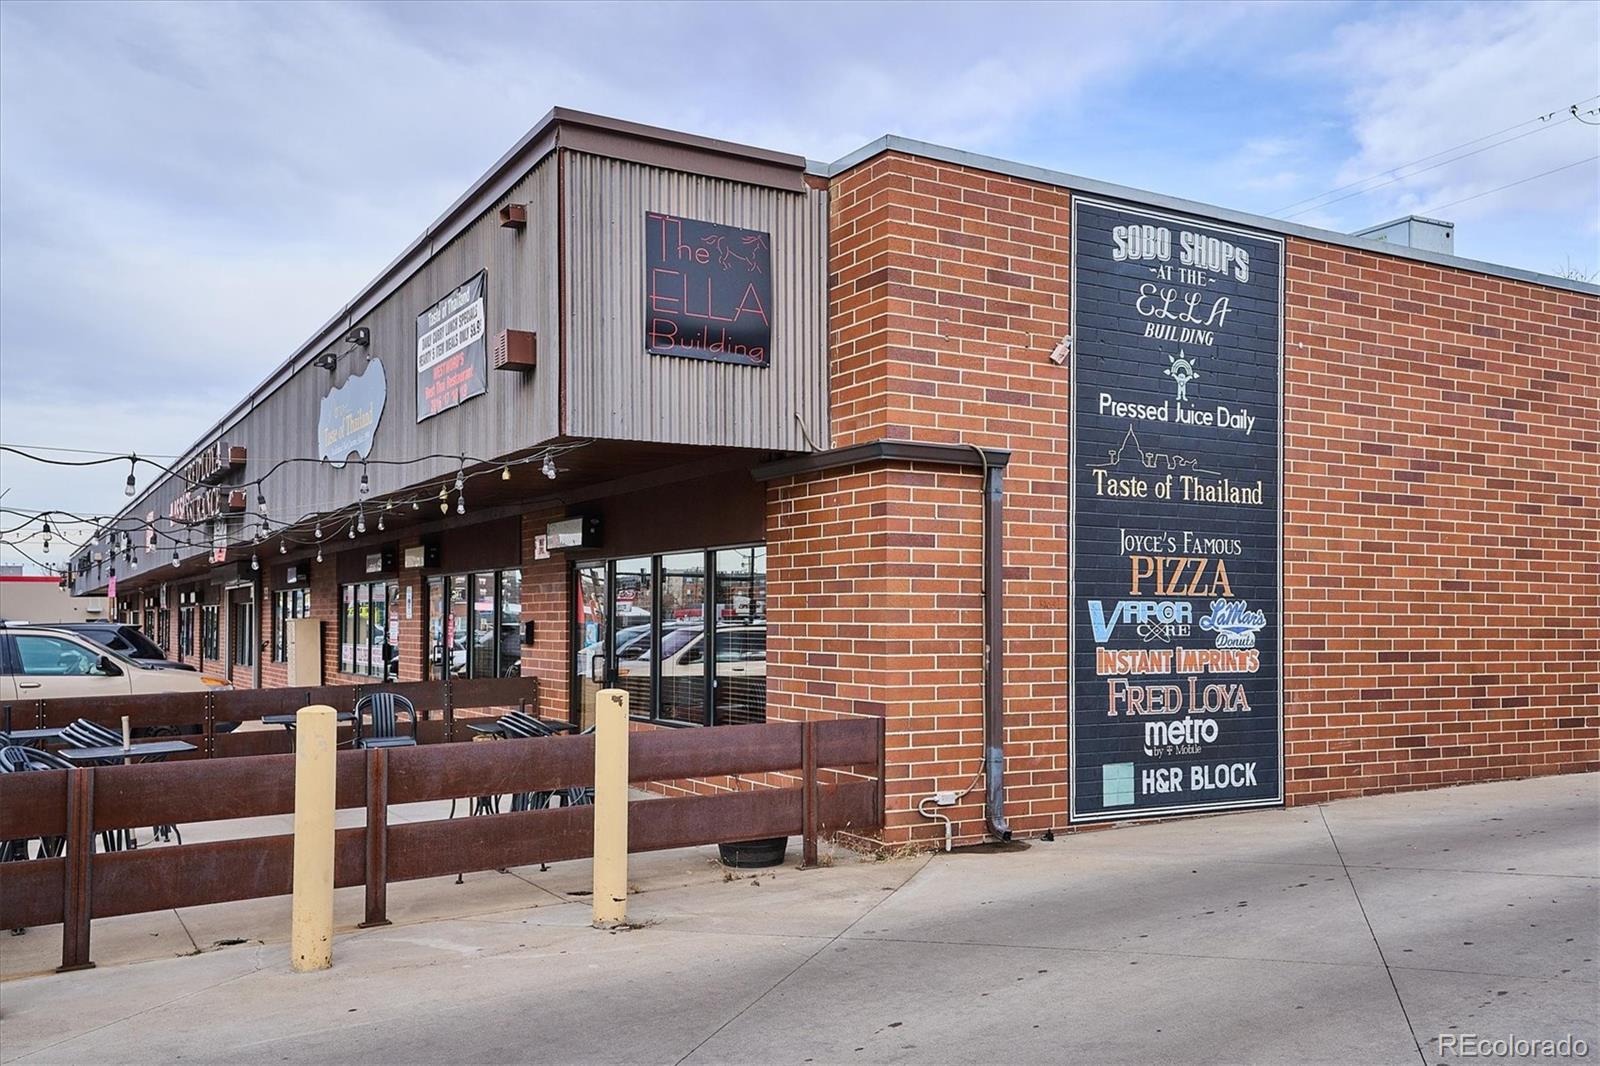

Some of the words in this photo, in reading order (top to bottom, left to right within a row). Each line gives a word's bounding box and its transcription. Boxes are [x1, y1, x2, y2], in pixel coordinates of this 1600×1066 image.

[649, 214, 710, 264] The
[1112, 225, 1171, 262] SOBO
[1180, 230, 1249, 283] SHOPS
[649, 268, 769, 327] ELLA
[1136, 283, 1232, 327] ELLA
[649, 318, 764, 363] Building
[1144, 322, 1214, 346] BUILDING
[1099, 392, 1168, 422] Pressed
[1174, 401, 1213, 426] Juice
[1217, 406, 1256, 435] Daily
[1093, 469, 1147, 498] Taste
[1155, 474, 1173, 499] of
[1180, 475, 1263, 505] Thailand
[1183, 531, 1242, 555] FAMOUS
[1128, 555, 1235, 597] PIZZA
[1216, 633, 1255, 648] Donuts
[1096, 647, 1173, 675] INSTANT
[1175, 646, 1260, 674] IMPRINTS
[1107, 678, 1183, 716] FRED
[1187, 676, 1251, 713] LOYA
[1144, 716, 1219, 748] metro
[1153, 746, 1164, 759] by
[1142, 767, 1183, 794] H&R
[1190, 762, 1257, 791] BLOCK
